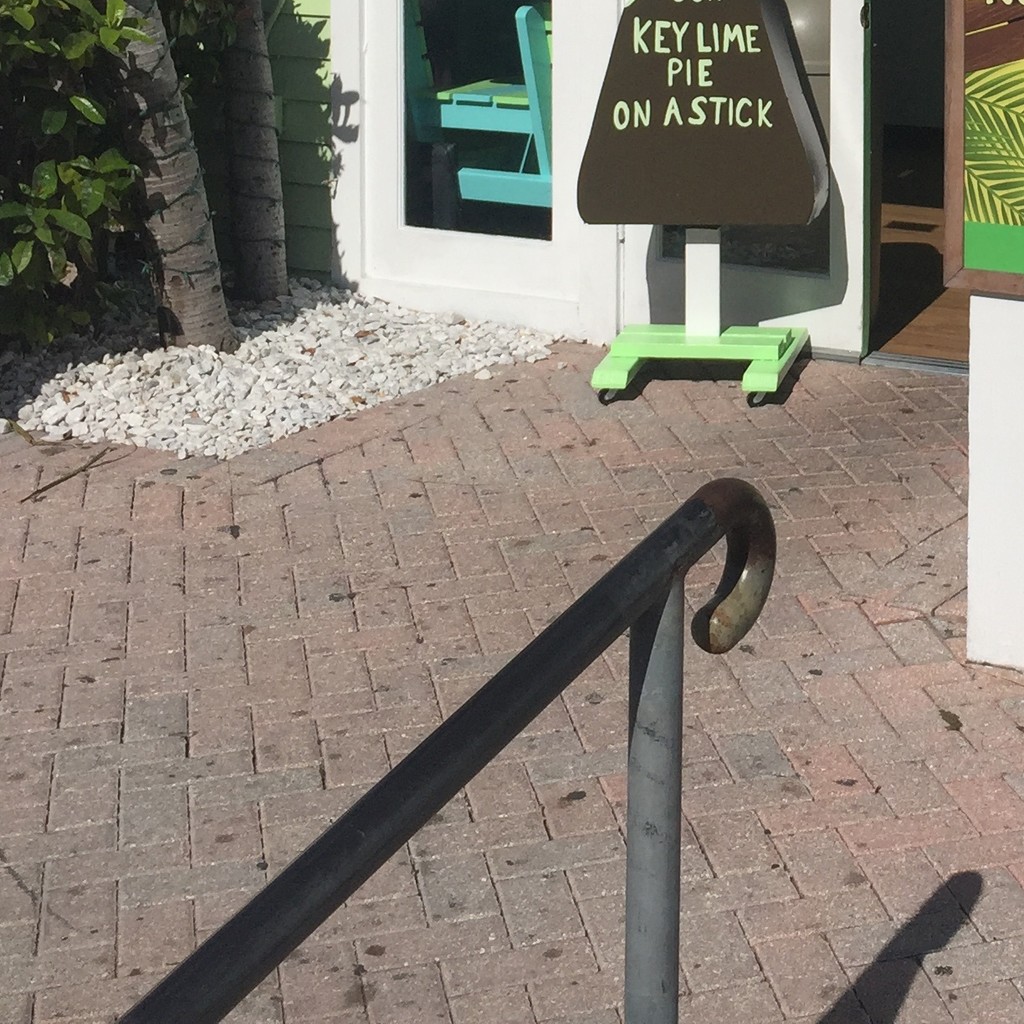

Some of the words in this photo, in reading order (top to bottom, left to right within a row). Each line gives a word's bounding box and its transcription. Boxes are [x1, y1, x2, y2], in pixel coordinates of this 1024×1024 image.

[633, 16, 690, 54] KEY
[696, 22, 761, 53] LIME
[667, 58, 713, 87] PIE
[613, 99, 651, 131] ON
[663, 96, 684, 126] A
[687, 96, 773, 128] STICK
